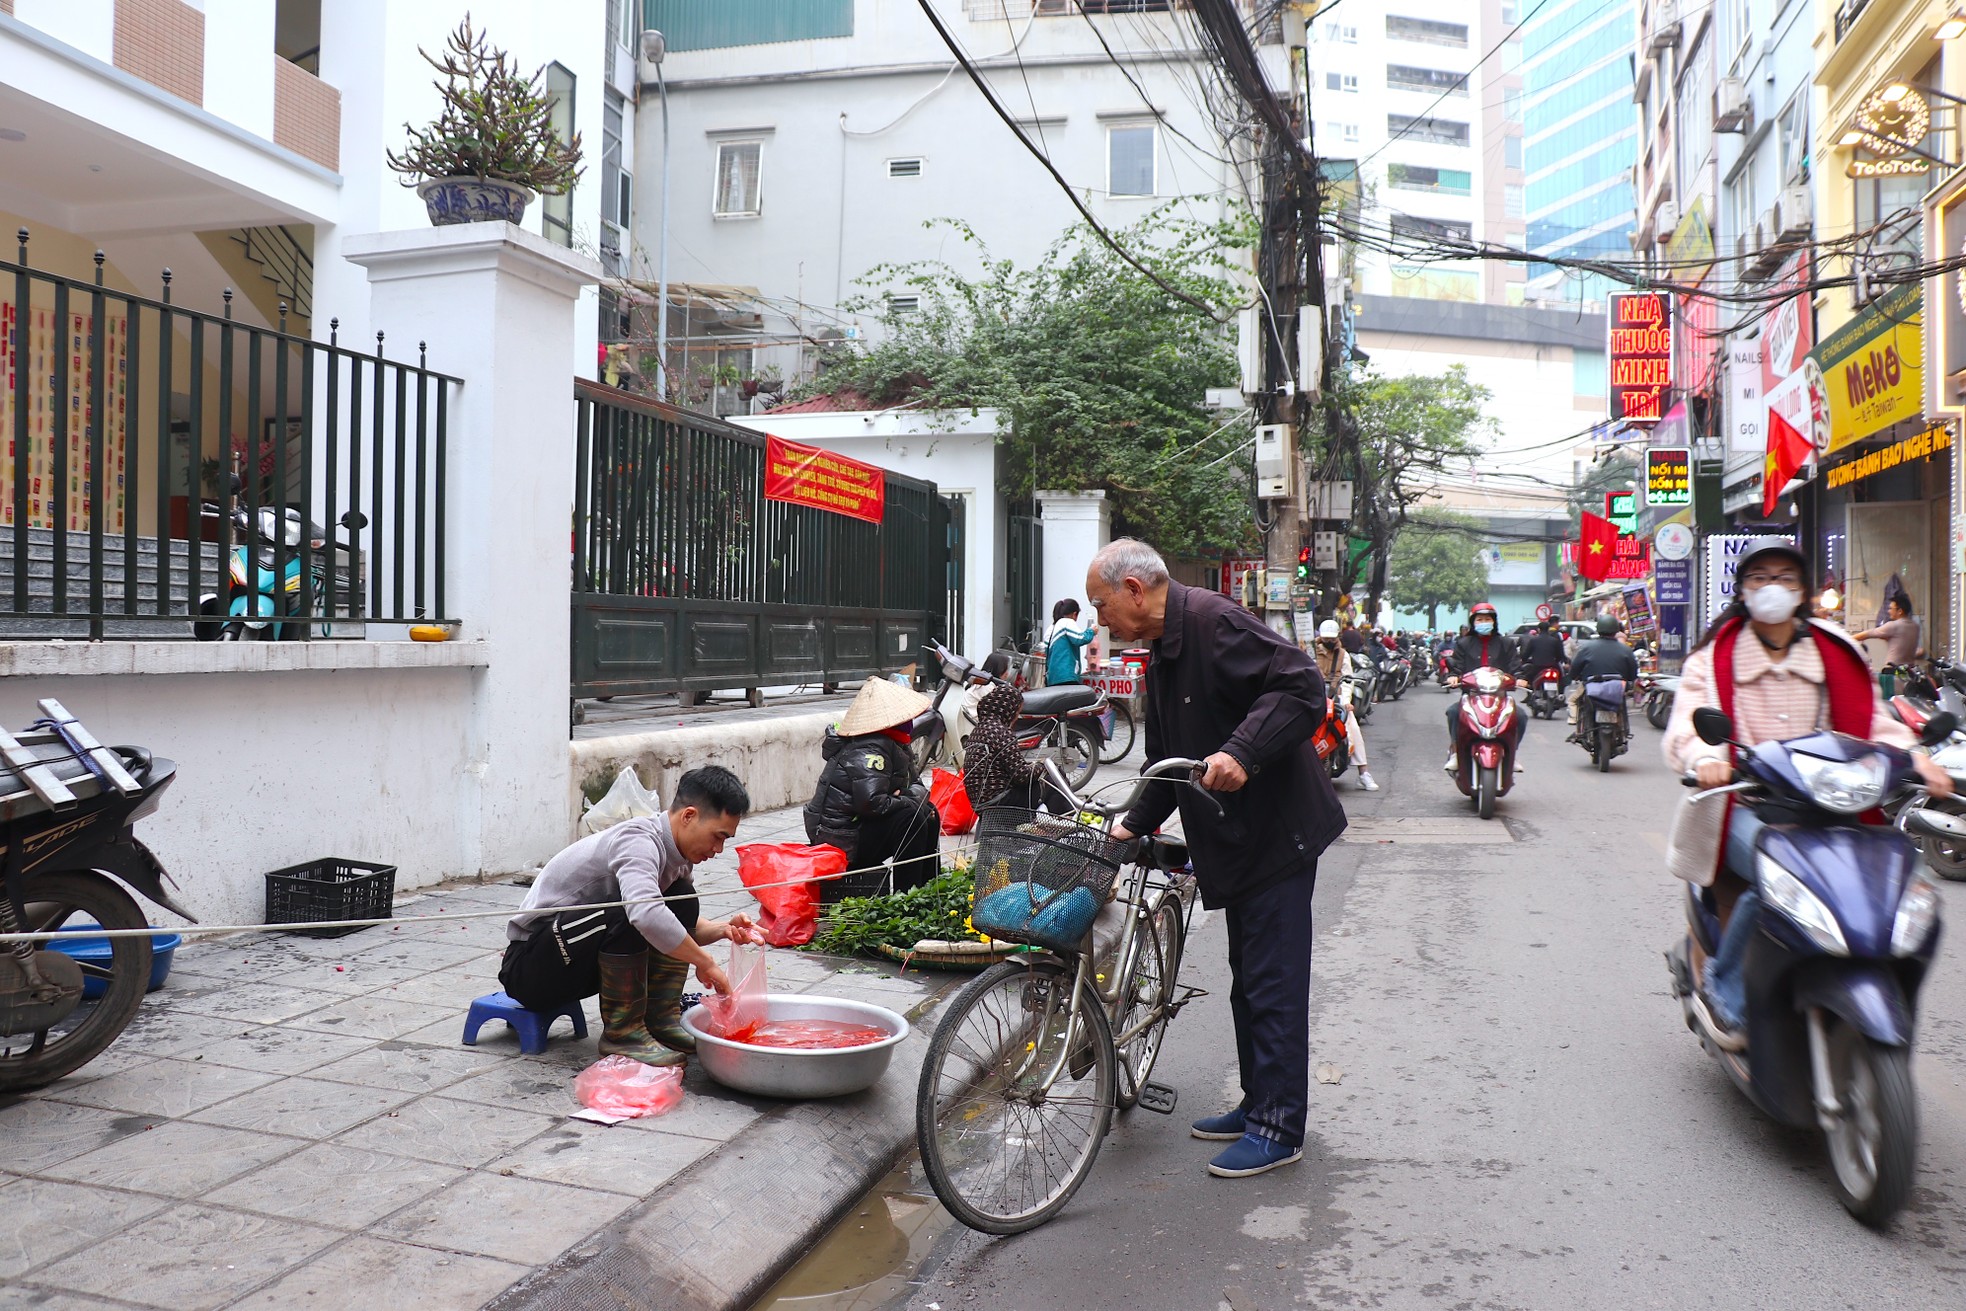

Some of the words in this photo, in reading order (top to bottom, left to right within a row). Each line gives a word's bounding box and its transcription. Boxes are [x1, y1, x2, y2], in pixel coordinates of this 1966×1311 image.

[1620, 293, 1662, 322] NHÀ
[1611, 319, 1671, 354] THUỐC
[1735, 352, 1763, 364] NAILS
[1612, 359, 1671, 385] MINH
[1621, 386, 1661, 419] TRÍ
[1743, 388, 1755, 399] MI
[1871, 396, 1896, 419] Taiwan
[1652, 451, 1687, 461] NAILS
[1856, 449, 1880, 480] BÁNH
[1881, 441, 1903, 470] BAO
[1903, 423, 1933, 463] NGHỆ
[1651, 462, 1672, 475] NỐI
[1673, 465, 1688, 475] MI
[1109, 679, 1133, 695] PHO
[23, 814, 98, 855] LADE
